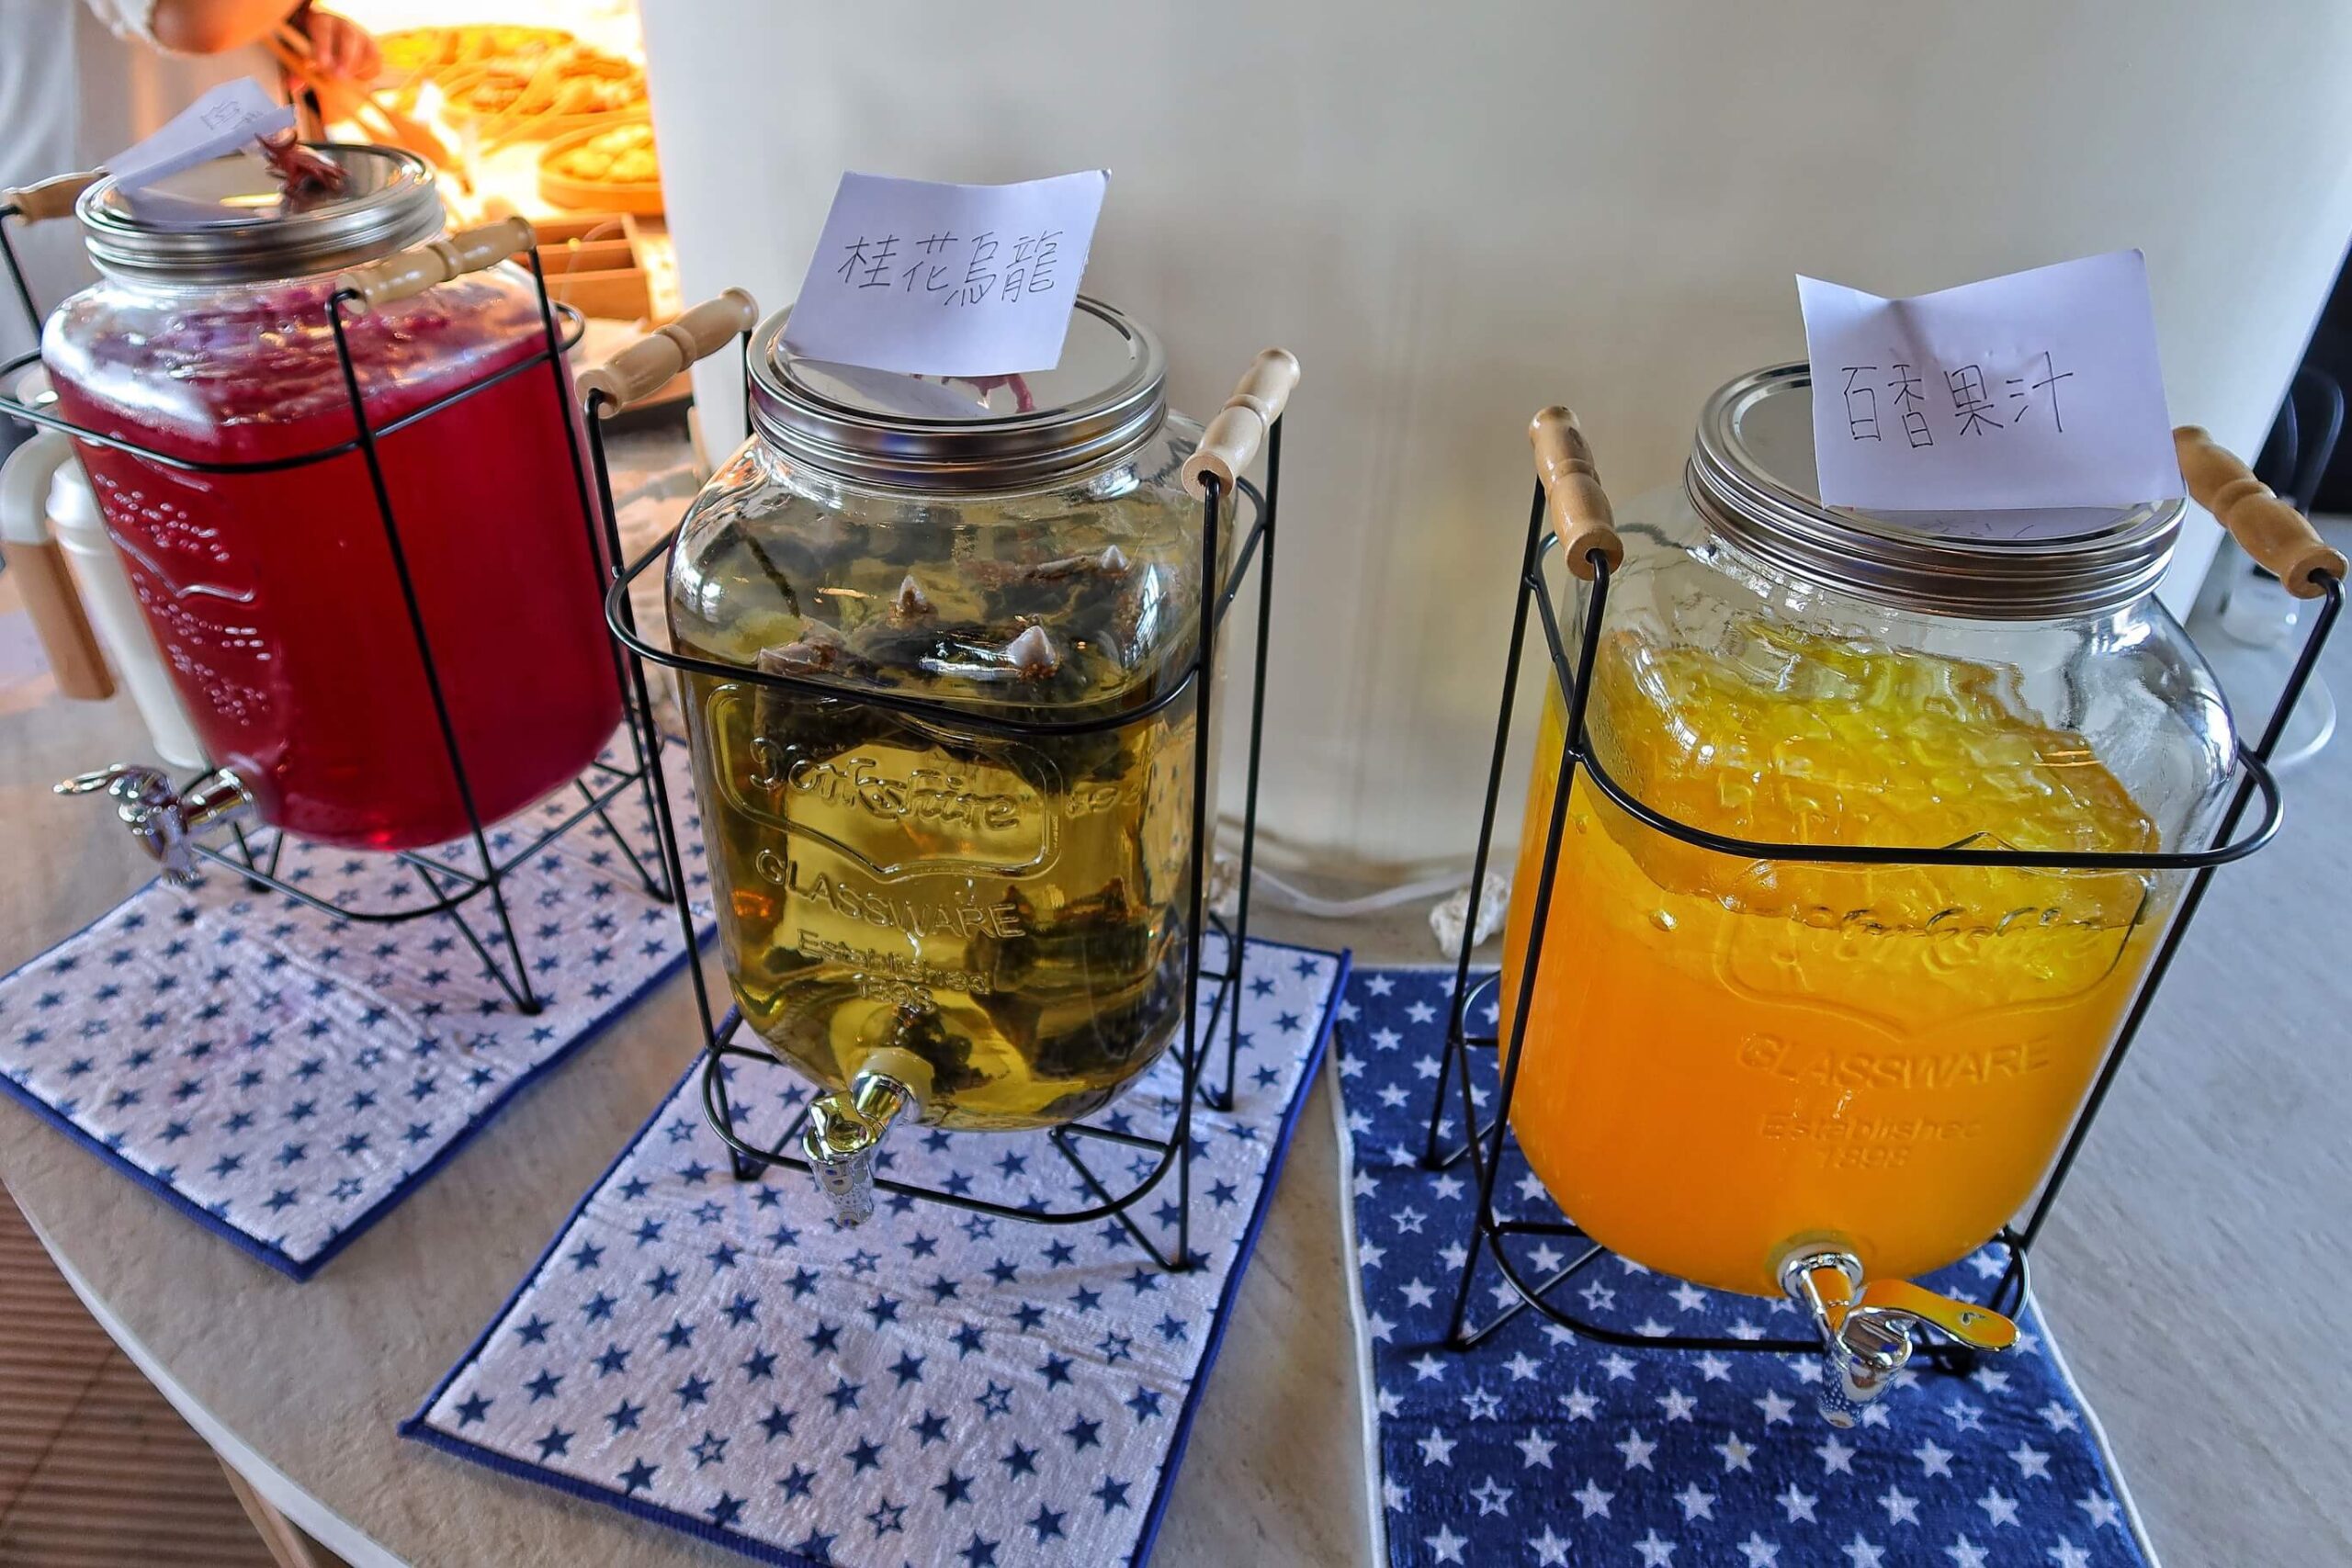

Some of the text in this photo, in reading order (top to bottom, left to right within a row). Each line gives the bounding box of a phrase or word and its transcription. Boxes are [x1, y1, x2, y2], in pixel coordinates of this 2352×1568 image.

[837, 231, 1064, 307] 桂花烏龍
[1841, 350, 2074, 449] 百香果汁
[755, 848, 1026, 939] GLASSWARE
[1736, 1031, 2052, 1089] GLASSWARE
